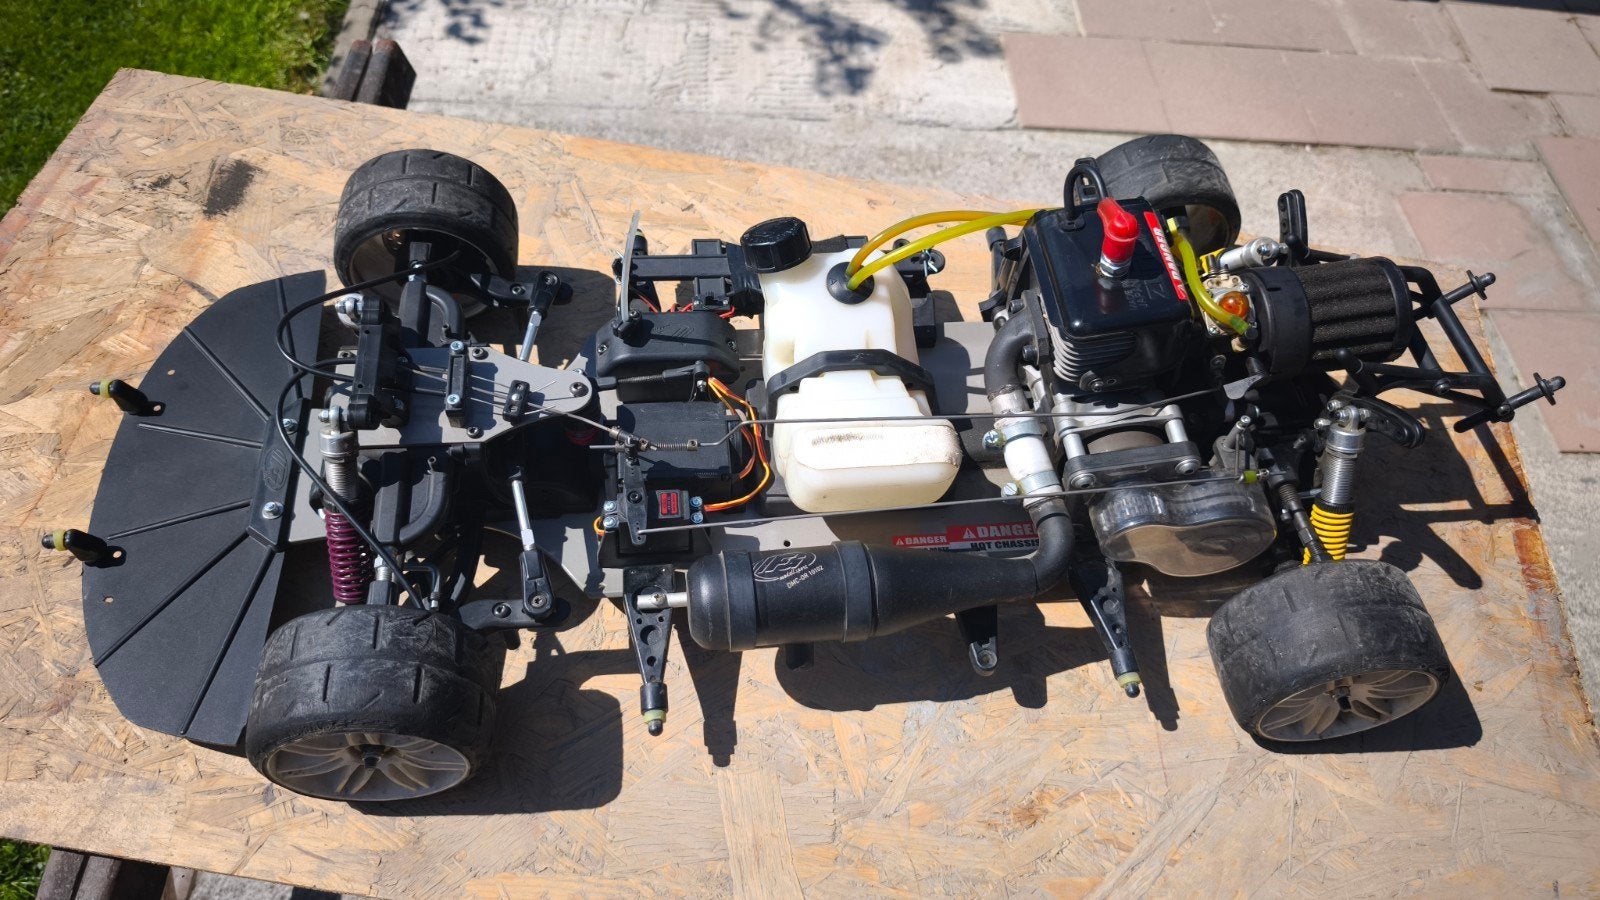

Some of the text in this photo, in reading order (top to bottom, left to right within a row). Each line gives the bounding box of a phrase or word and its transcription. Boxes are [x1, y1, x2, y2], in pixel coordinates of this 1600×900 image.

[1153, 227, 1182, 281] DANGER
[905, 535, 947, 546] DANGER
[970, 541, 992, 551] HOT
[808, 564, 824, 576] 10102
